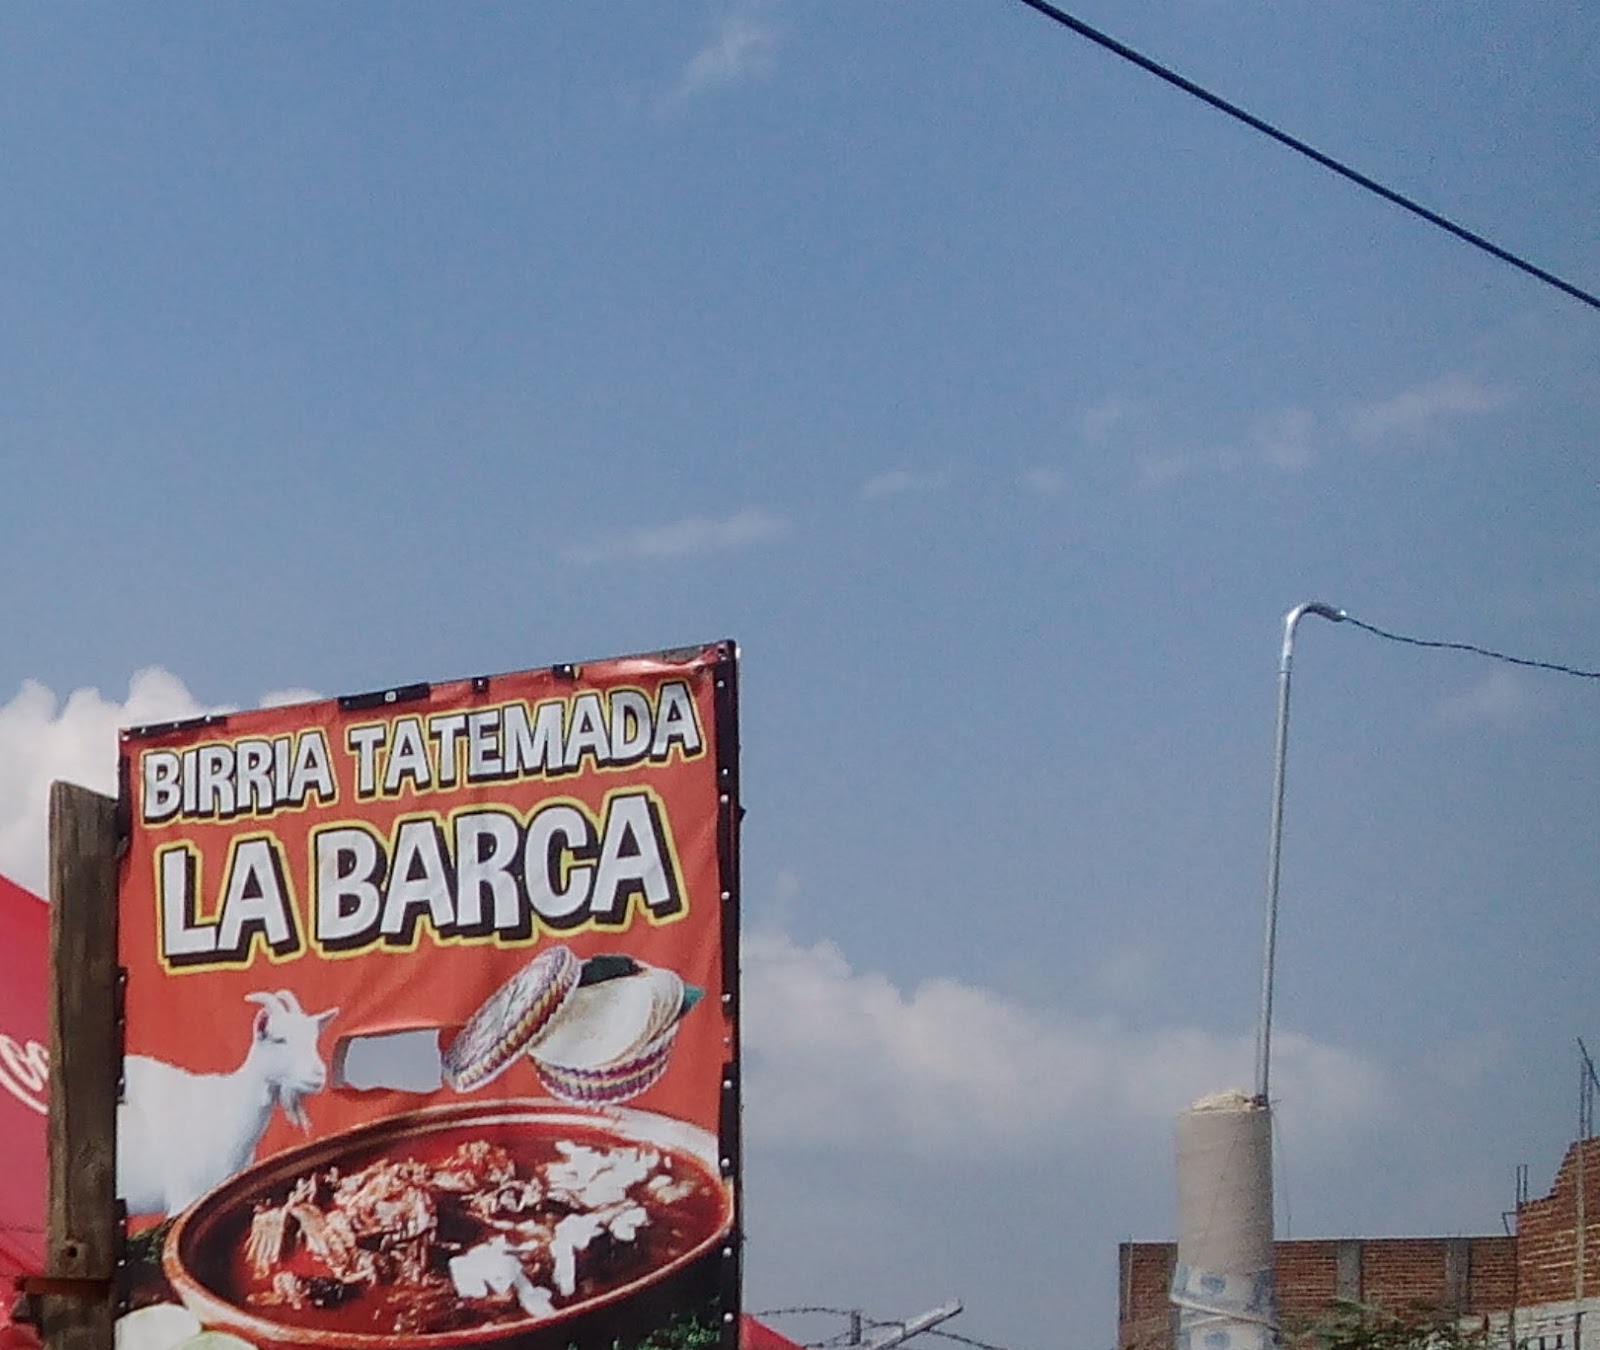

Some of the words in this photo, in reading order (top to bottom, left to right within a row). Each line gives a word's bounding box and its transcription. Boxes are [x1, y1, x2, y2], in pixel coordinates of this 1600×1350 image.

[143, 731, 337, 821] BIRRIA
[348, 681, 704, 798] TATEMADA
[159, 837, 302, 967] LA
[314, 792, 682, 952] BARCA
